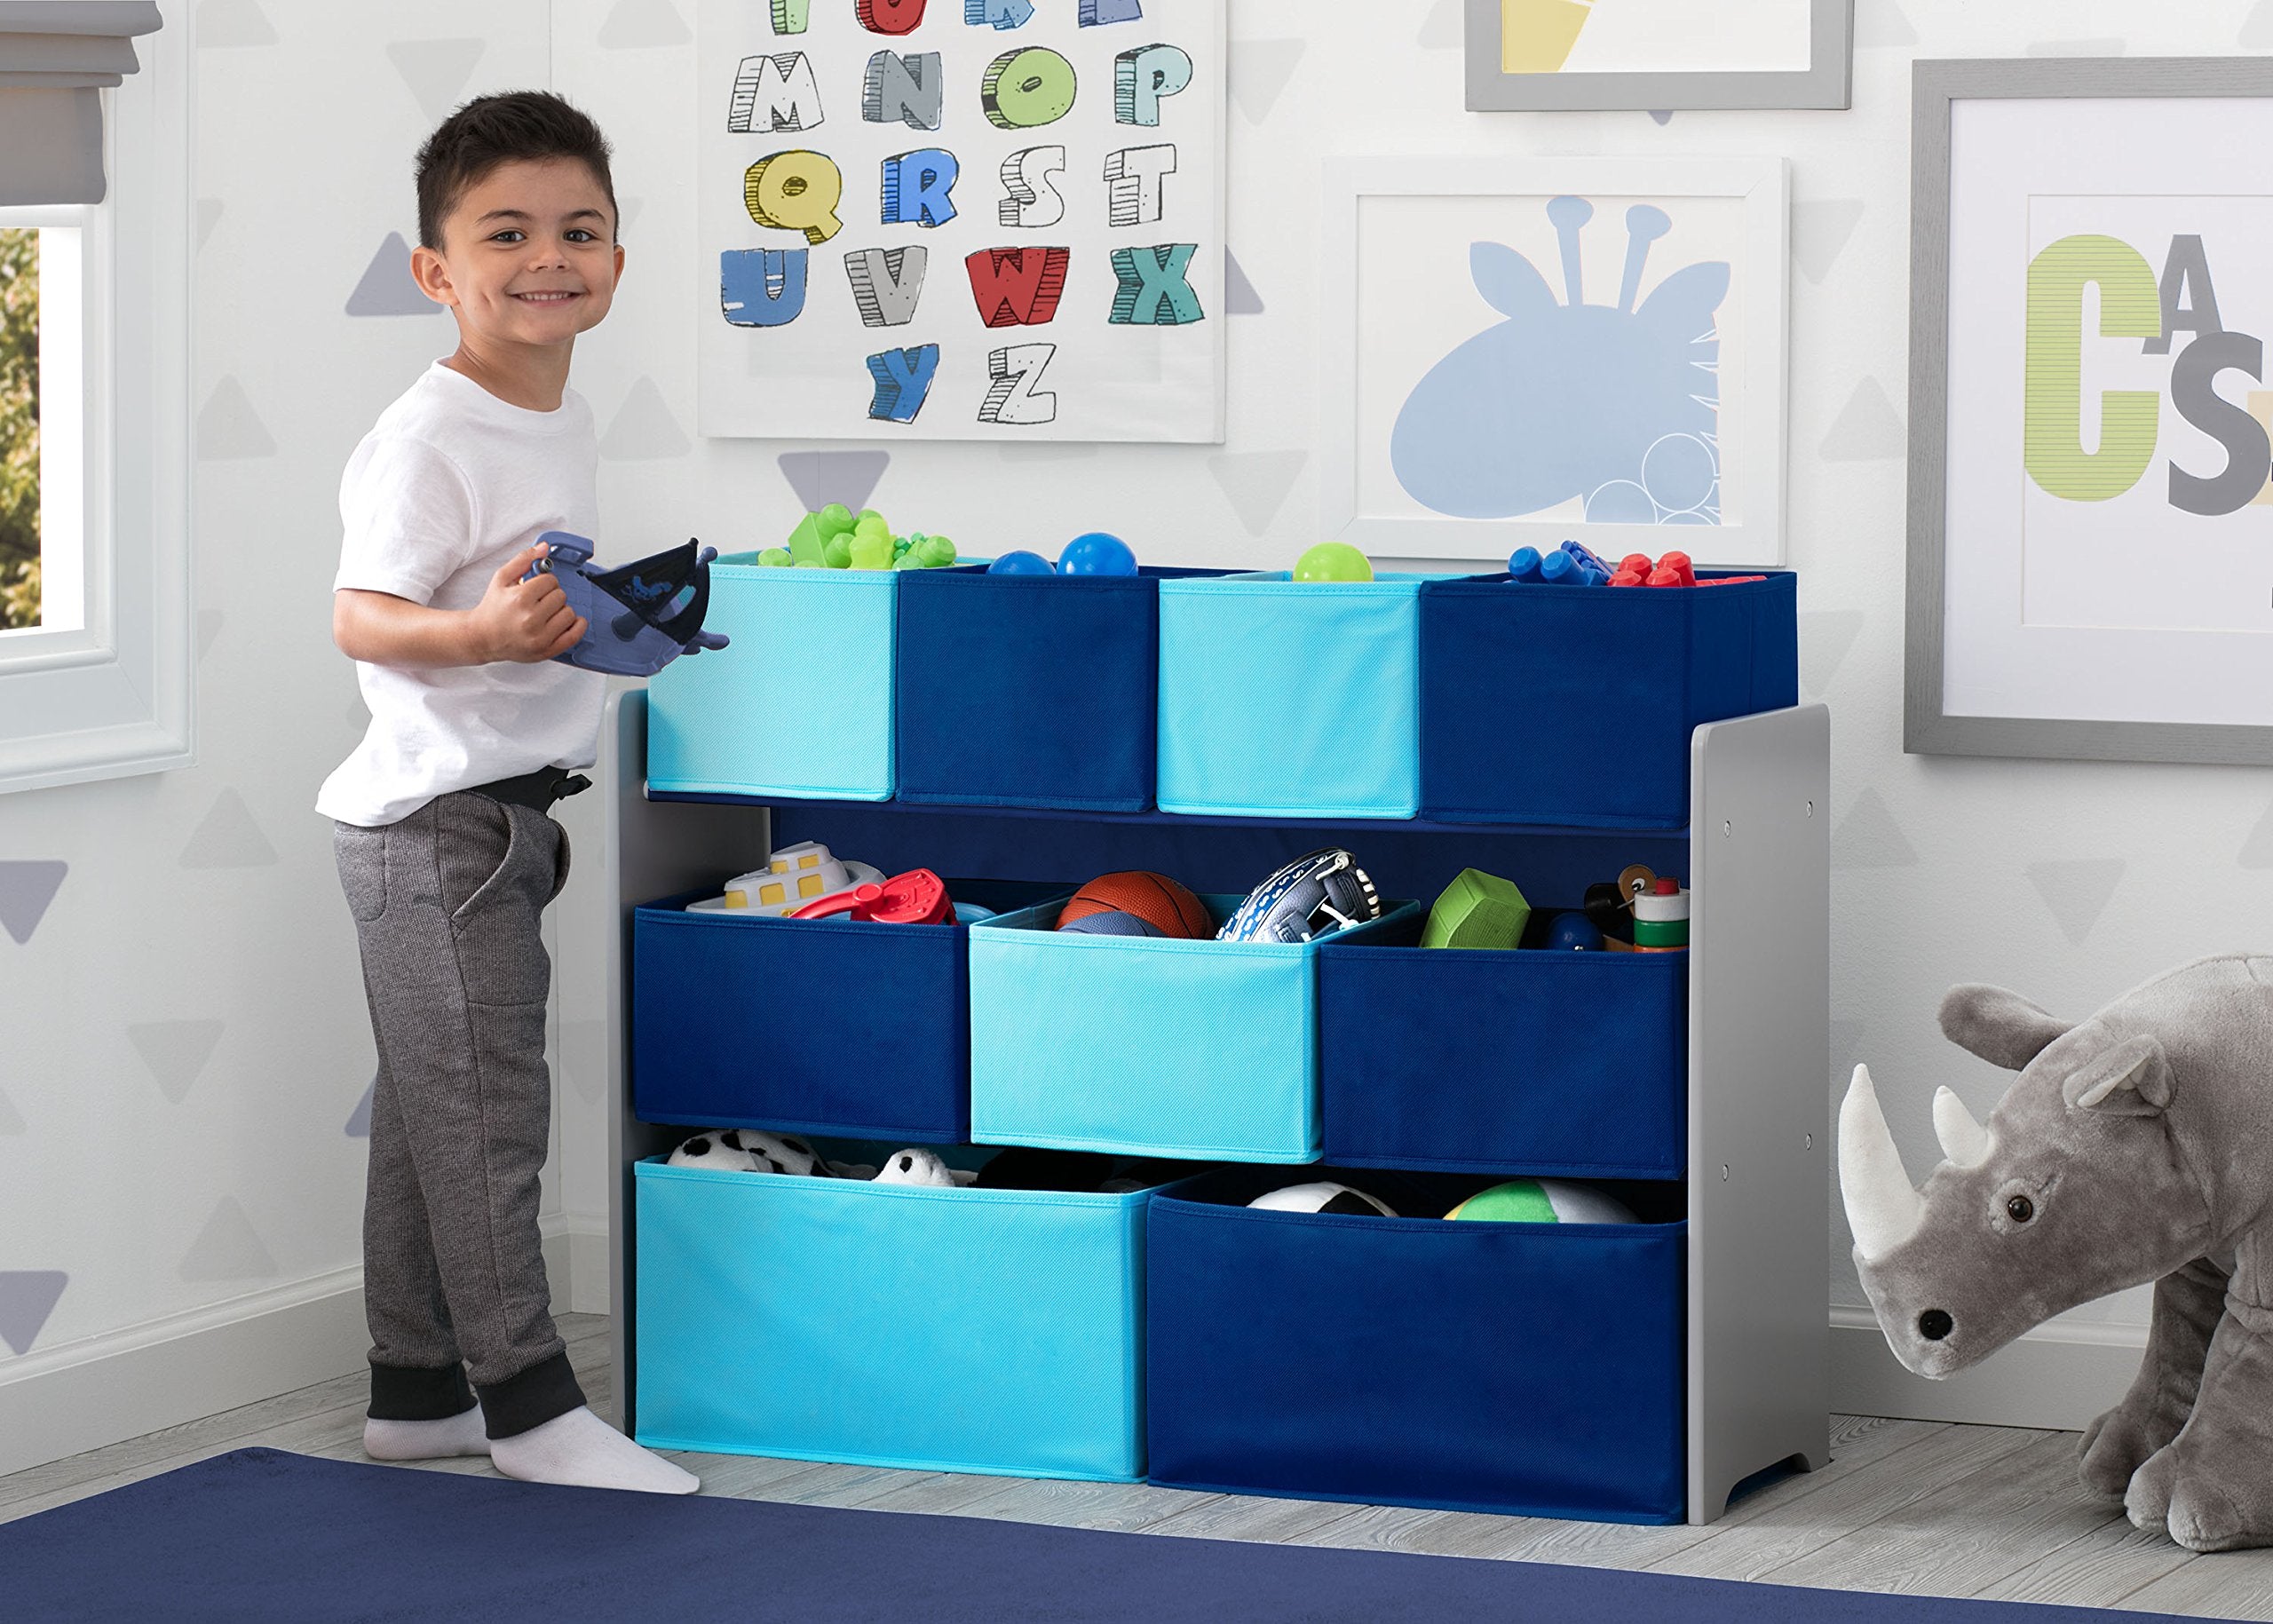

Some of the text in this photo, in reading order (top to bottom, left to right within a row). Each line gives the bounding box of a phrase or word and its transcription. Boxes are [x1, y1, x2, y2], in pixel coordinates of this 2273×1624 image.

[728, 44, 1192, 133] M N O P
[744, 144, 1176, 245] Q R S T
[720, 243, 1205, 328] U V W X
[866, 343, 1057, 424] Y Z
[2024, 234, 2273, 516] CAS
